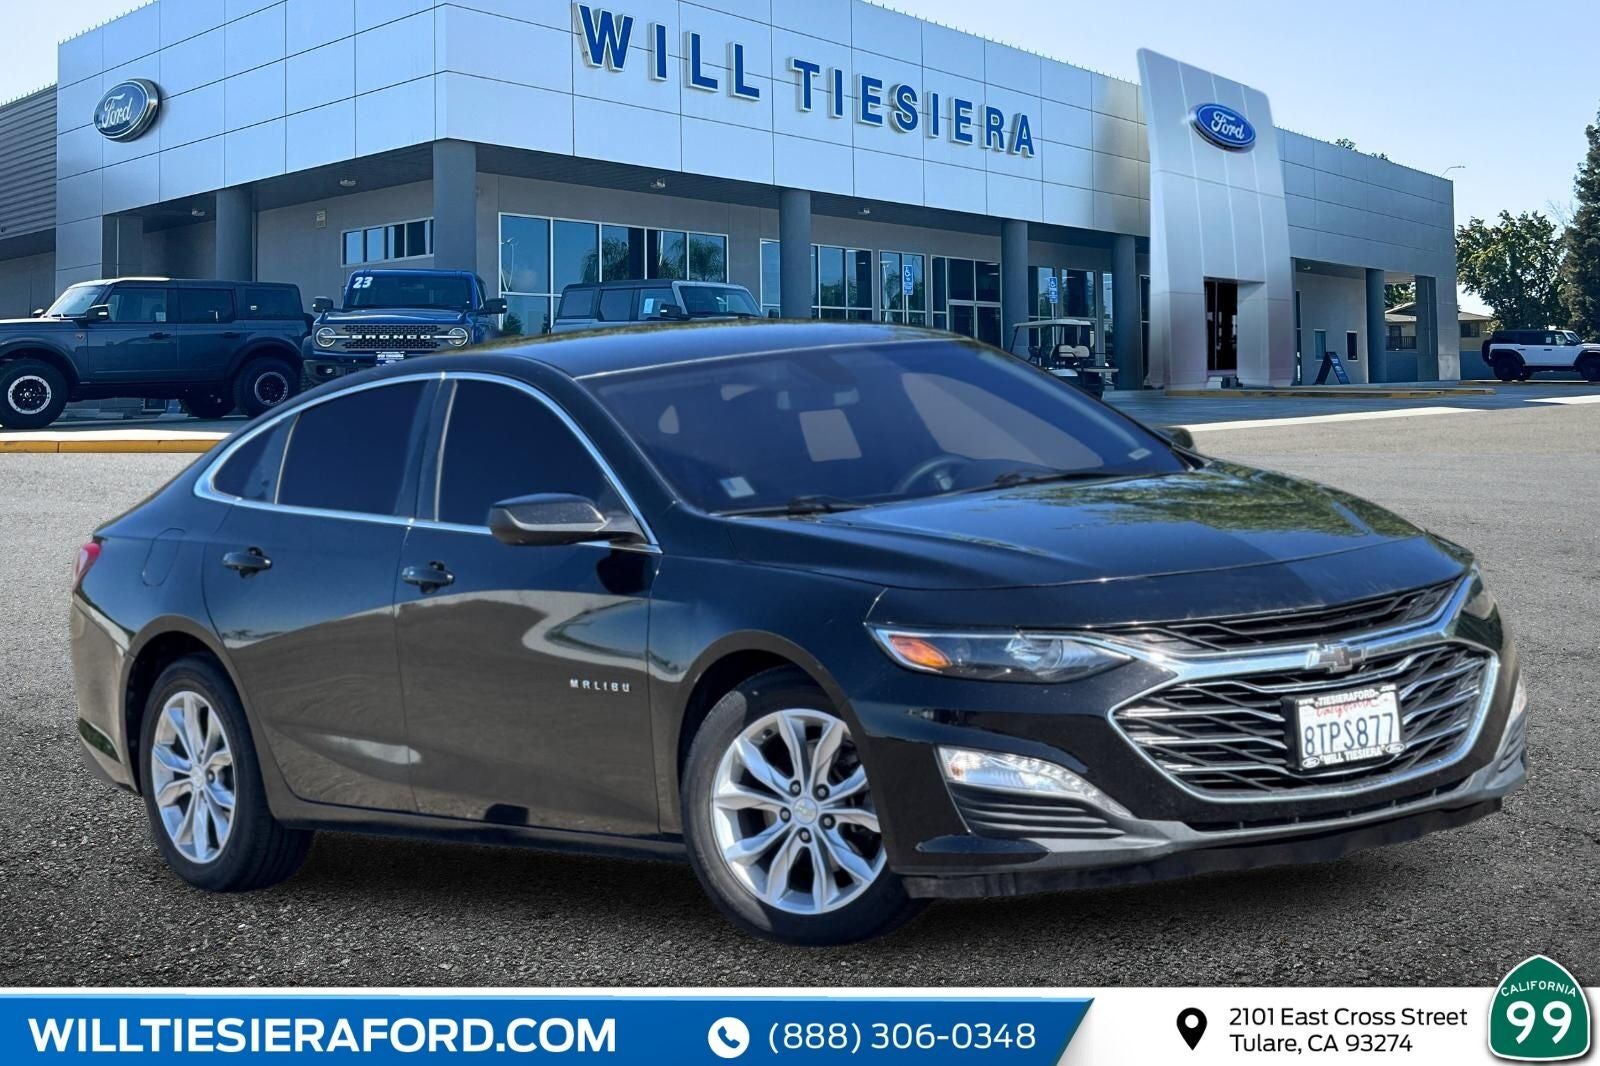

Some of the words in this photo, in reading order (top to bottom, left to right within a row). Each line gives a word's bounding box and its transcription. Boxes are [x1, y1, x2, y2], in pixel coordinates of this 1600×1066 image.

[576, 3, 760, 100] WILL
[790, 57, 1036, 158] TIESIERA
[101, 93, 133, 128] Ford
[1211, 110, 1245, 140] Ford
[352, 276, 374, 289] 23
[569, 678, 630, 692] MALIBU
[1304, 712, 1393, 756] 8TPS877
